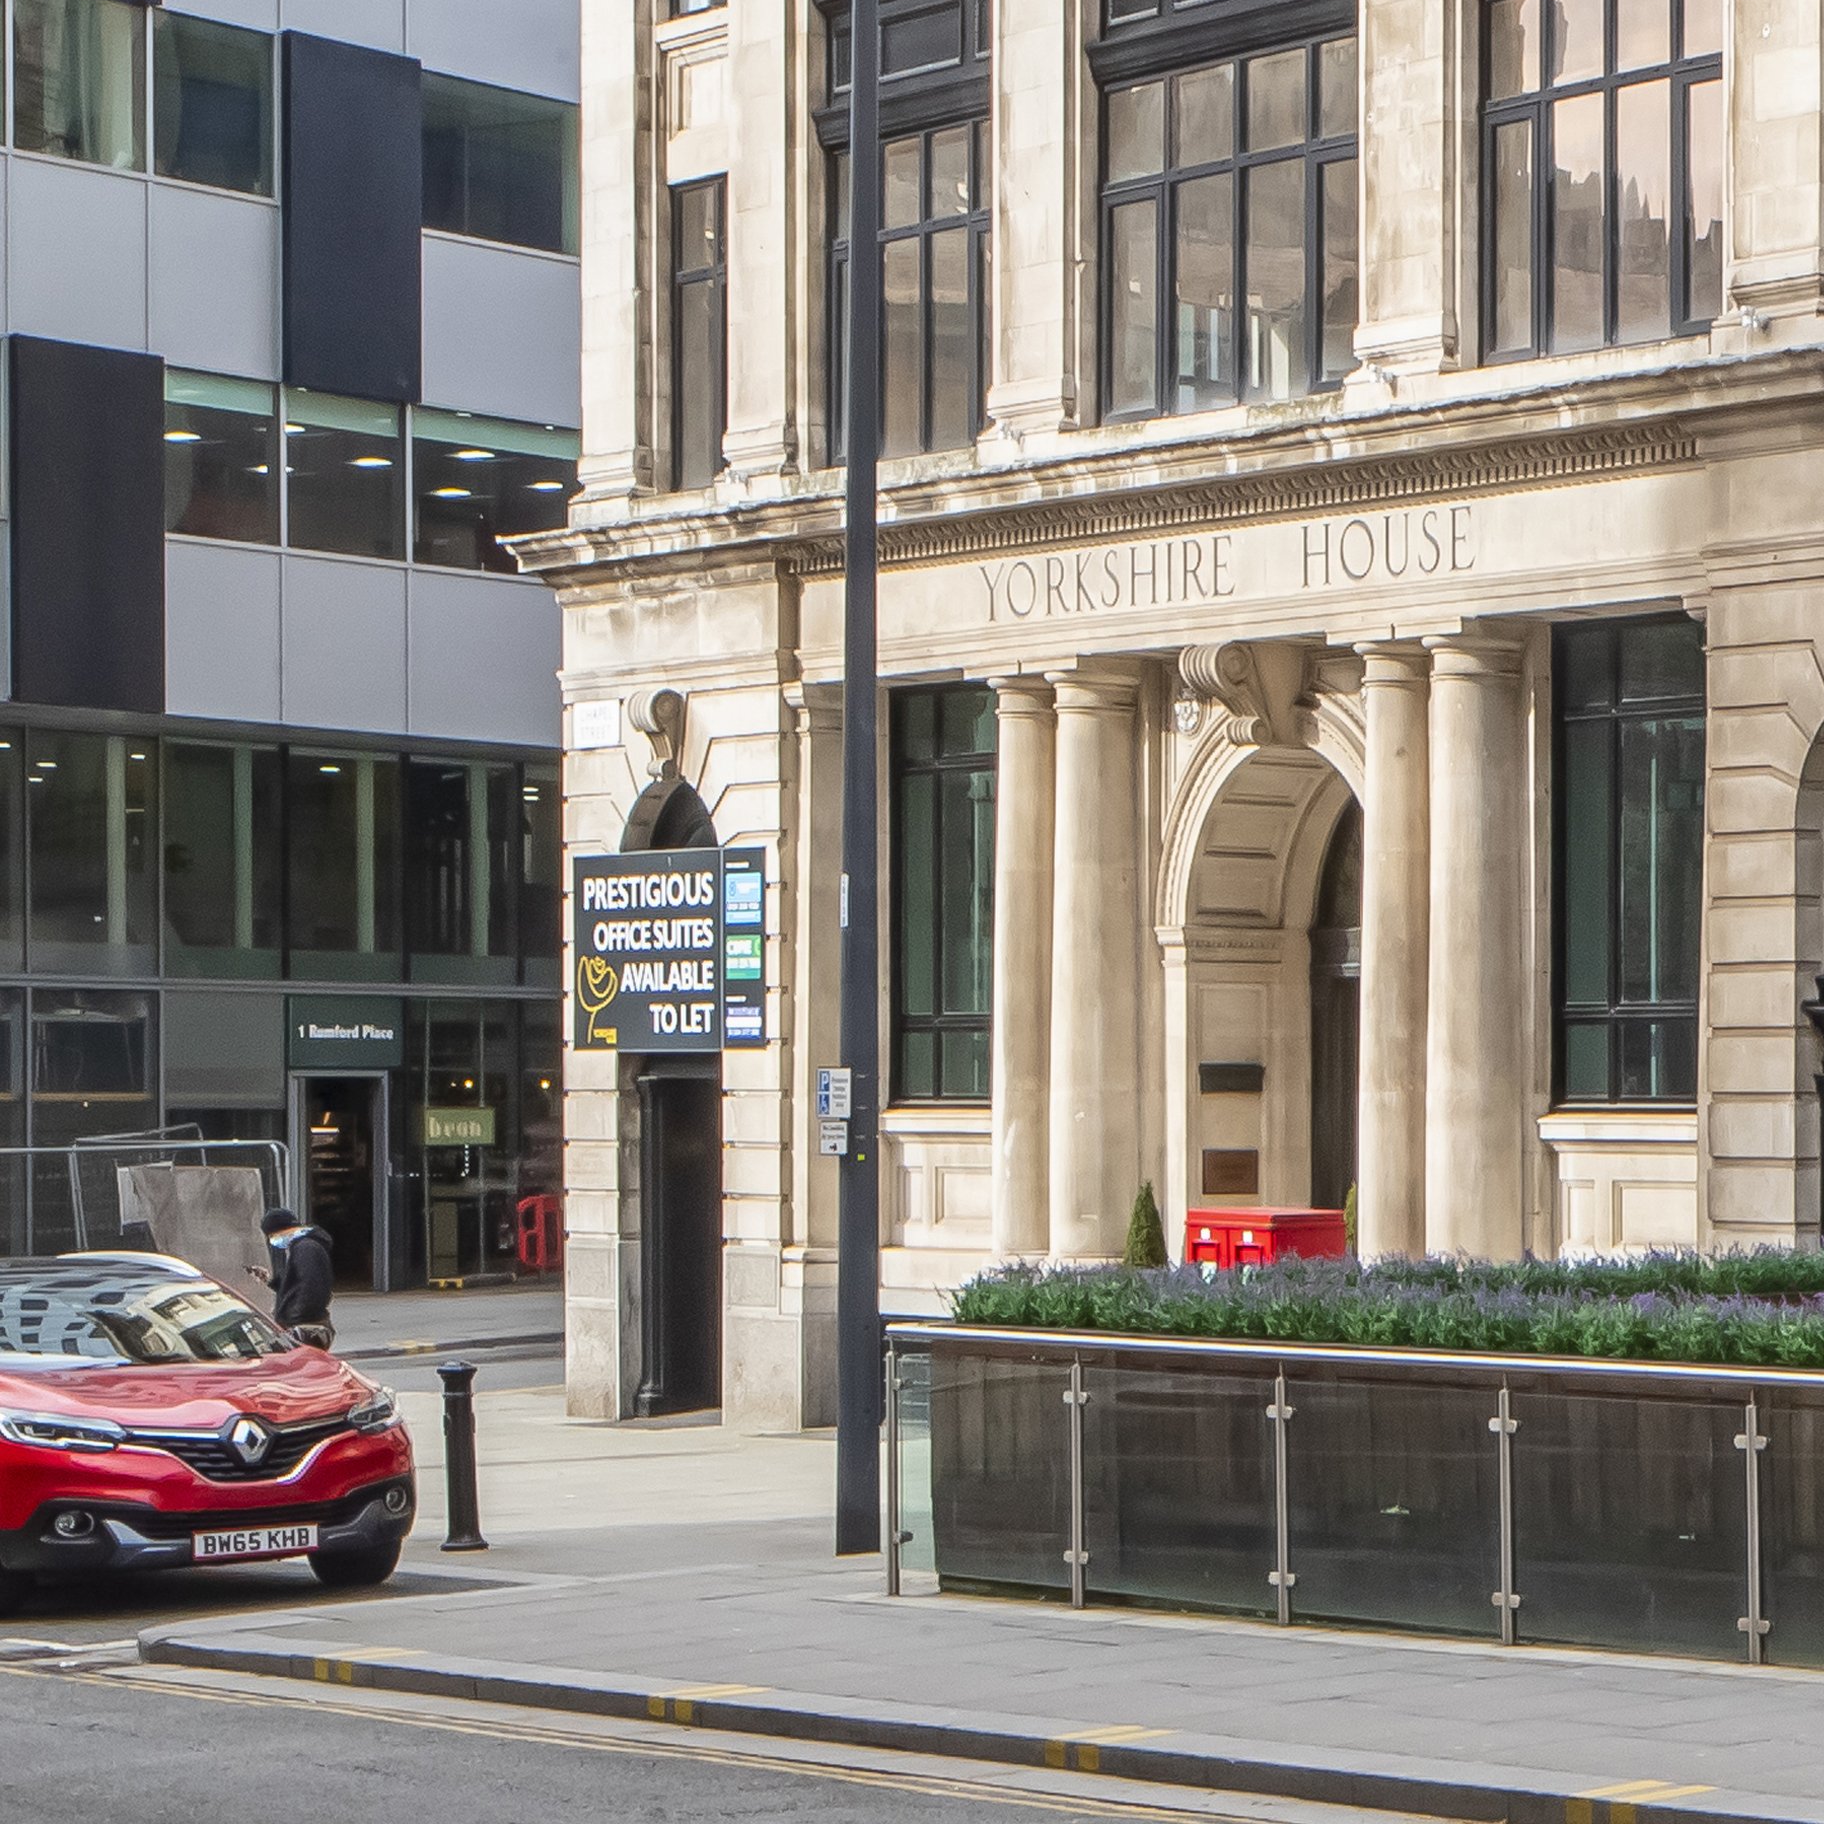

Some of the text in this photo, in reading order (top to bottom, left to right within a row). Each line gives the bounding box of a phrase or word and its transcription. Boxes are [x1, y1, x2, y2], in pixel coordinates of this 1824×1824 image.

[980, 505, 1477, 622] YORKSHIRE HOUSE
[582, 872, 714, 911] PRESTIGIOUS
[592, 918, 714, 952] OFFICE SUITES
[620, 960, 715, 993] AVAILABLE
[649, 1003, 715, 1034] TO LET
[203, 1527, 309, 1555] BW65 KHB
